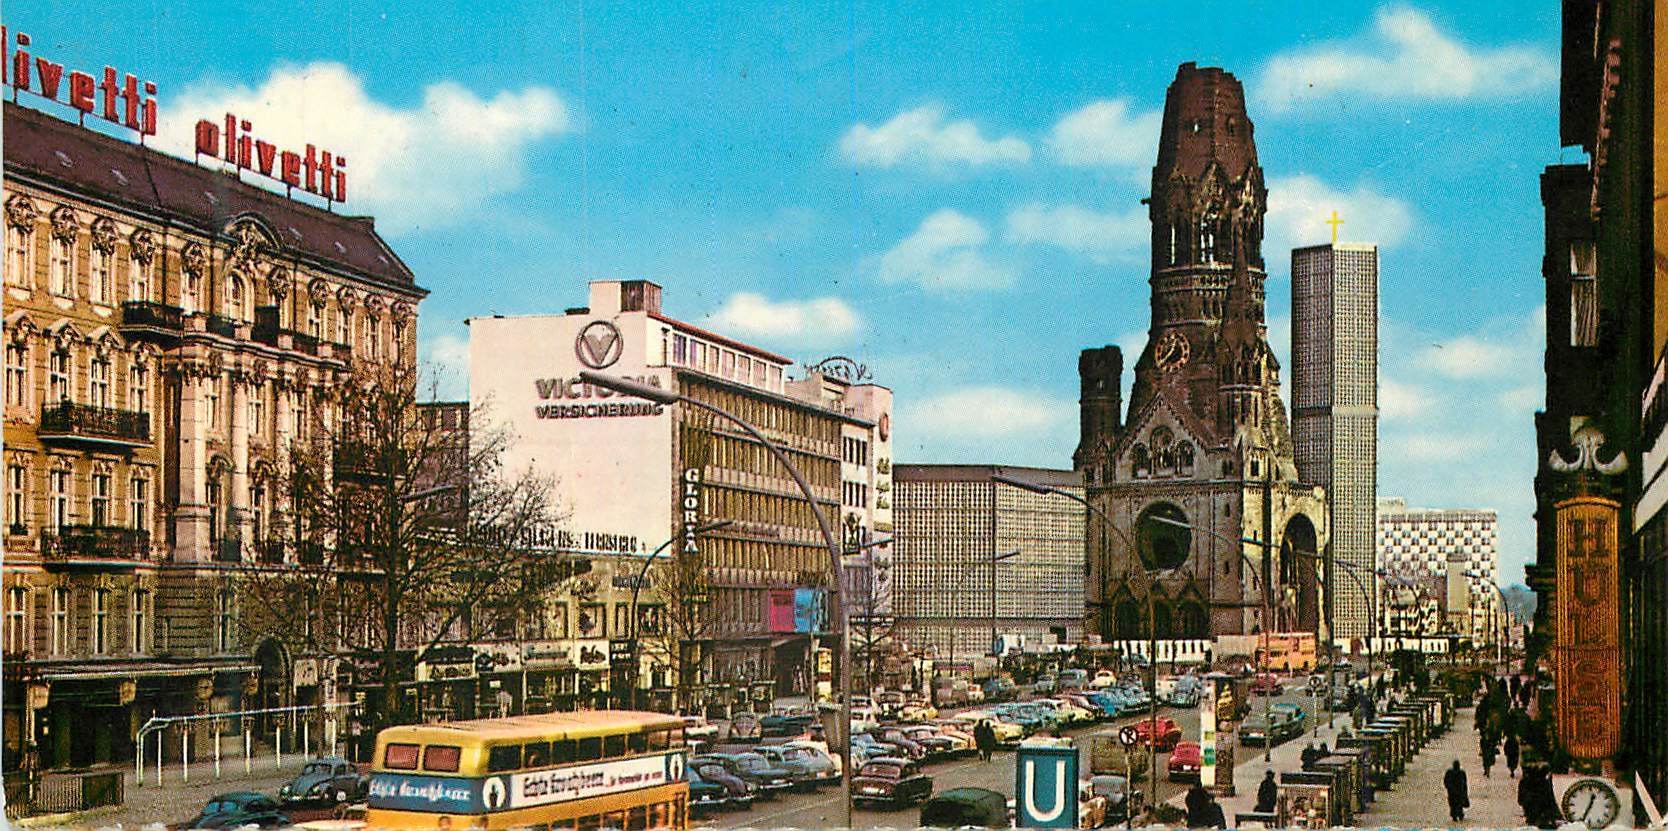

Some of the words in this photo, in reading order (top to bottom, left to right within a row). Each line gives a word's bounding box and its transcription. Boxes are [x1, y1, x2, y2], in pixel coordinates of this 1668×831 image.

[195, 113, 347, 203] olivetti
[535, 403, 664, 419] VERSICHERUNG
[684, 468, 699, 552] GLORIA
[1025, 760, 1066, 822] U
